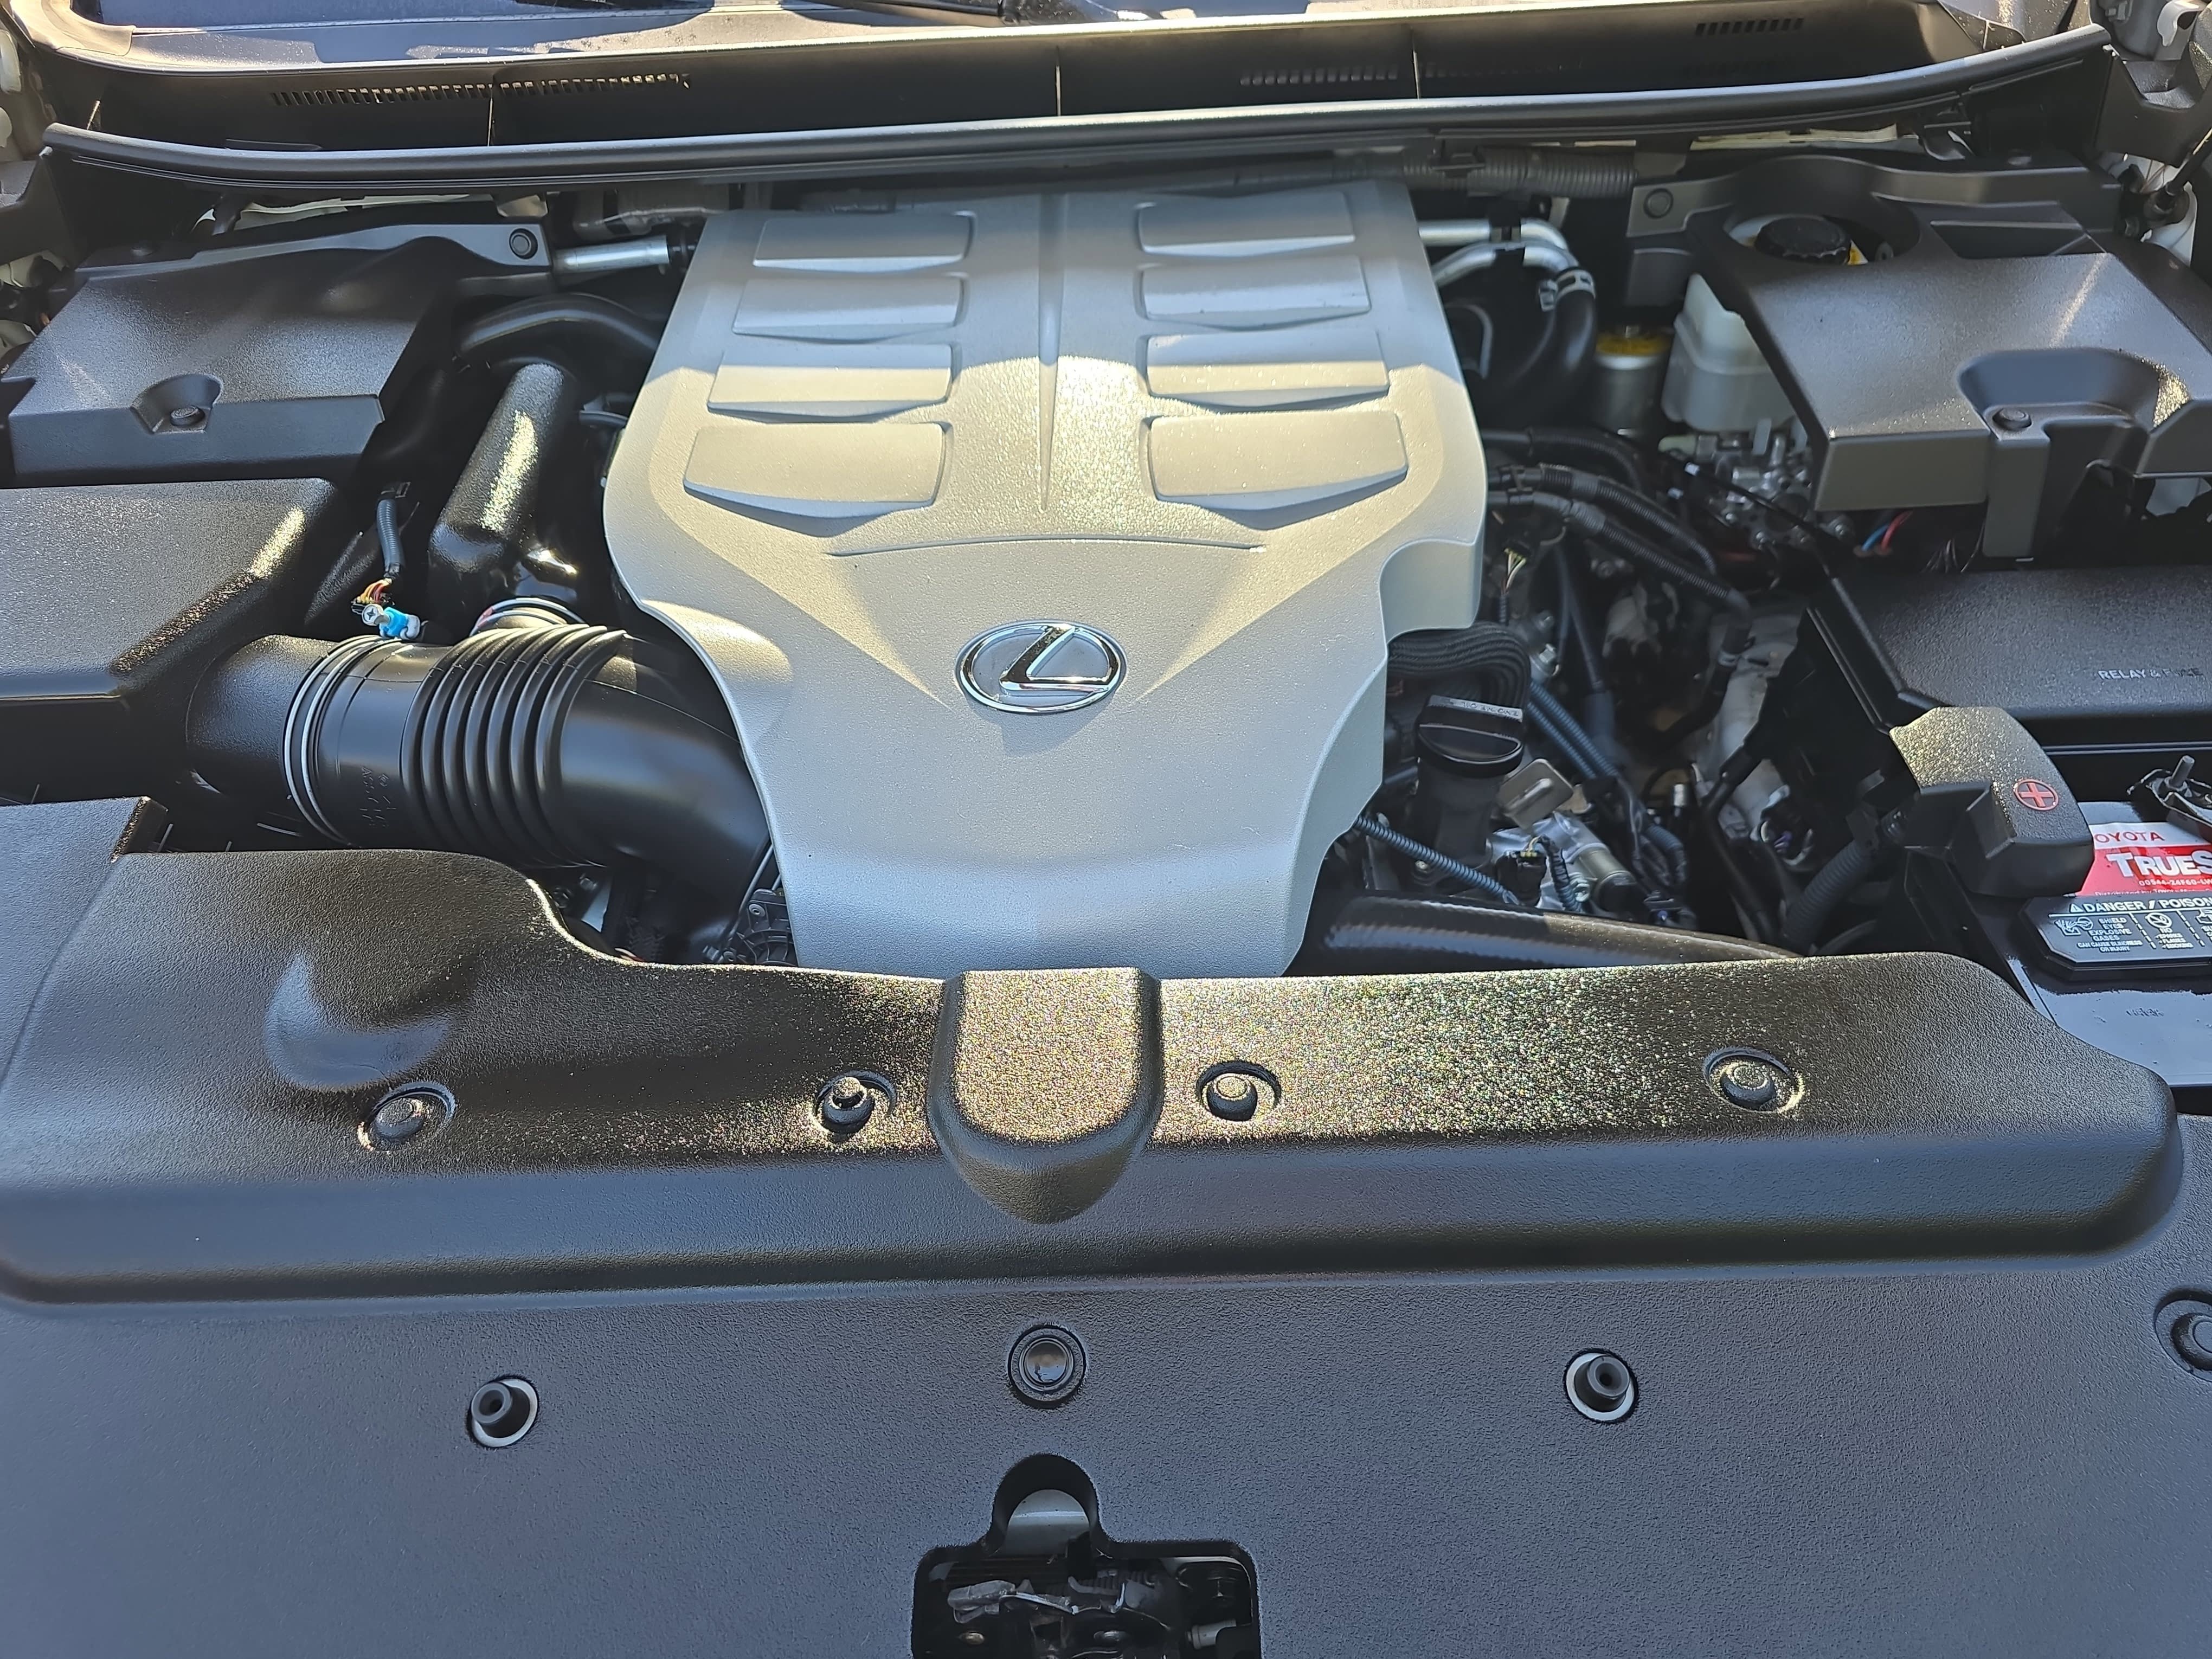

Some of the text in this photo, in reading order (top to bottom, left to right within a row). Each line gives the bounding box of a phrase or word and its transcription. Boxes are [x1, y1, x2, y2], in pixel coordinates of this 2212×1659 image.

[2098, 669, 2146, 679] RELAY
[2149, 669, 2162, 678] &
[2094, 832, 2165, 843] OYOTA
[2082, 901, 2147, 912] DANGER
[2158, 897, 2212, 908] POISON
